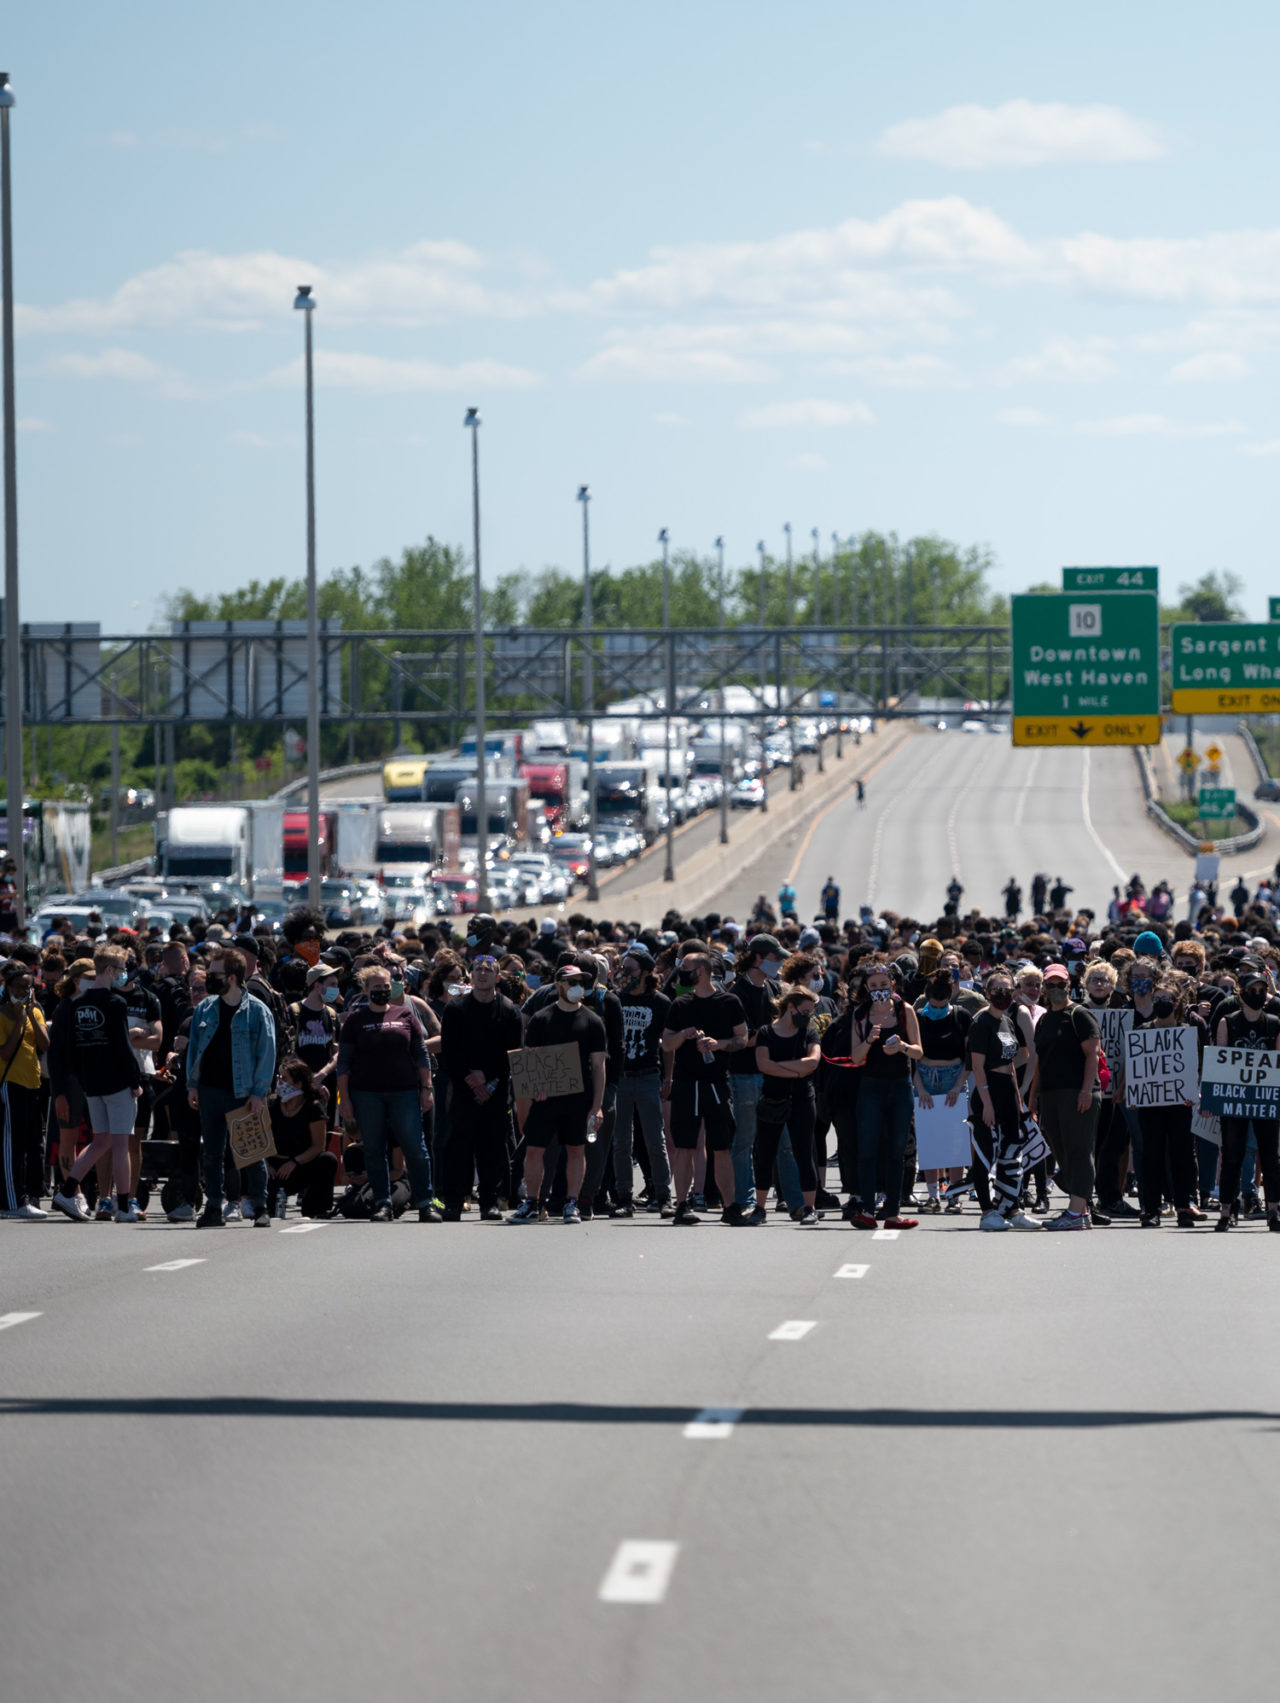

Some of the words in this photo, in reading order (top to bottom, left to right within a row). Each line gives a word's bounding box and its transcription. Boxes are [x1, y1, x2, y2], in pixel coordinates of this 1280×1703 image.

[1076, 573, 1105, 585] EXIT
[1116, 571, 1144, 586] 44
[1075, 611, 1097, 629] 10
[1030, 645, 1141, 663] Downtown
[1180, 636, 1267, 657] Sargent
[1024, 670, 1073, 686] West
[1081, 669, 1149, 685] Haven
[1180, 664, 1232, 684] Long
[1062, 694, 1069, 709] 1
[1078, 694, 1110, 707] MILE
[1218, 693, 1253, 707] EXIT
[1025, 724, 1059, 738] EXIT
[1103, 723, 1147, 738] ONLY
[1100, 1010, 1129, 1040] ACK
[1101, 1040, 1121, 1059] VES
[1127, 1029, 1185, 1058] BLACK
[511, 1050, 566, 1077] BLACK
[1132, 1051, 1186, 1079] LIVES
[528, 1066, 572, 1083] LIVES
[1239, 1069, 1268, 1084] UP
[520, 1077, 581, 1098] MATTER
[1127, 1079, 1186, 1106] MATTER
[1212, 1083, 1248, 1099] BLACK
[1222, 1102, 1278, 1118] MATTER
[236, 1123, 248, 1155] BLACK
